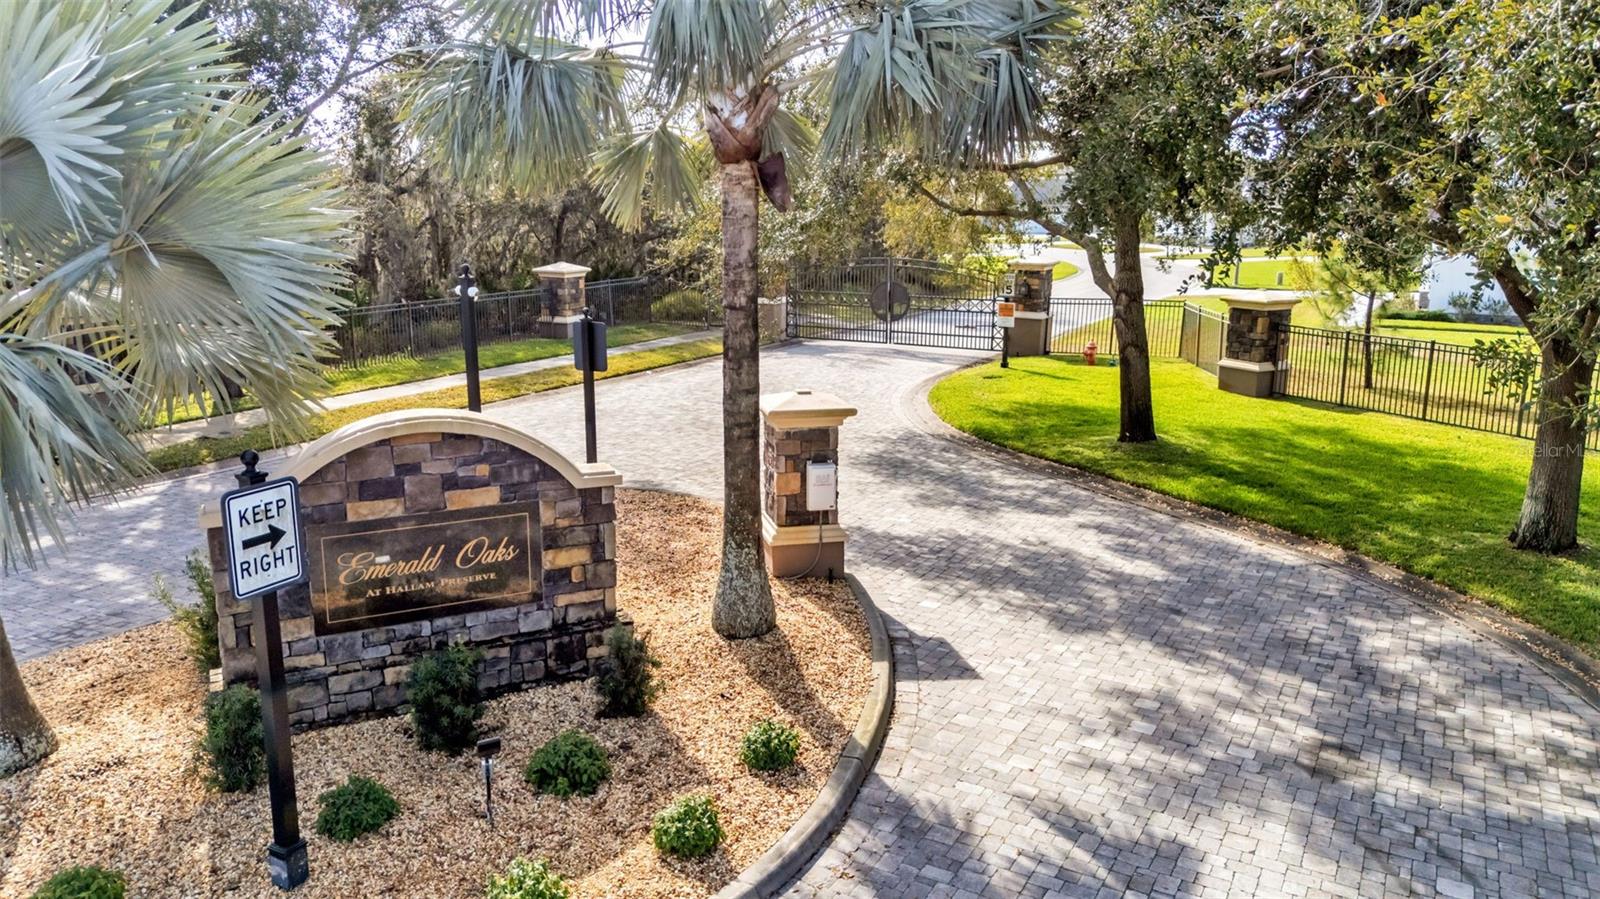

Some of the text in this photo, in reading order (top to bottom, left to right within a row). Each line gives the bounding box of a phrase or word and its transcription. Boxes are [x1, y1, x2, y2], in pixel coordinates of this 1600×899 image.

[238, 498, 287, 528] KEEP
[239, 545, 295, 580] RIGHT
[336, 536, 520, 586] Emerald Oaks
[366, 571, 497, 598] AT HALLAM PRESERVE
